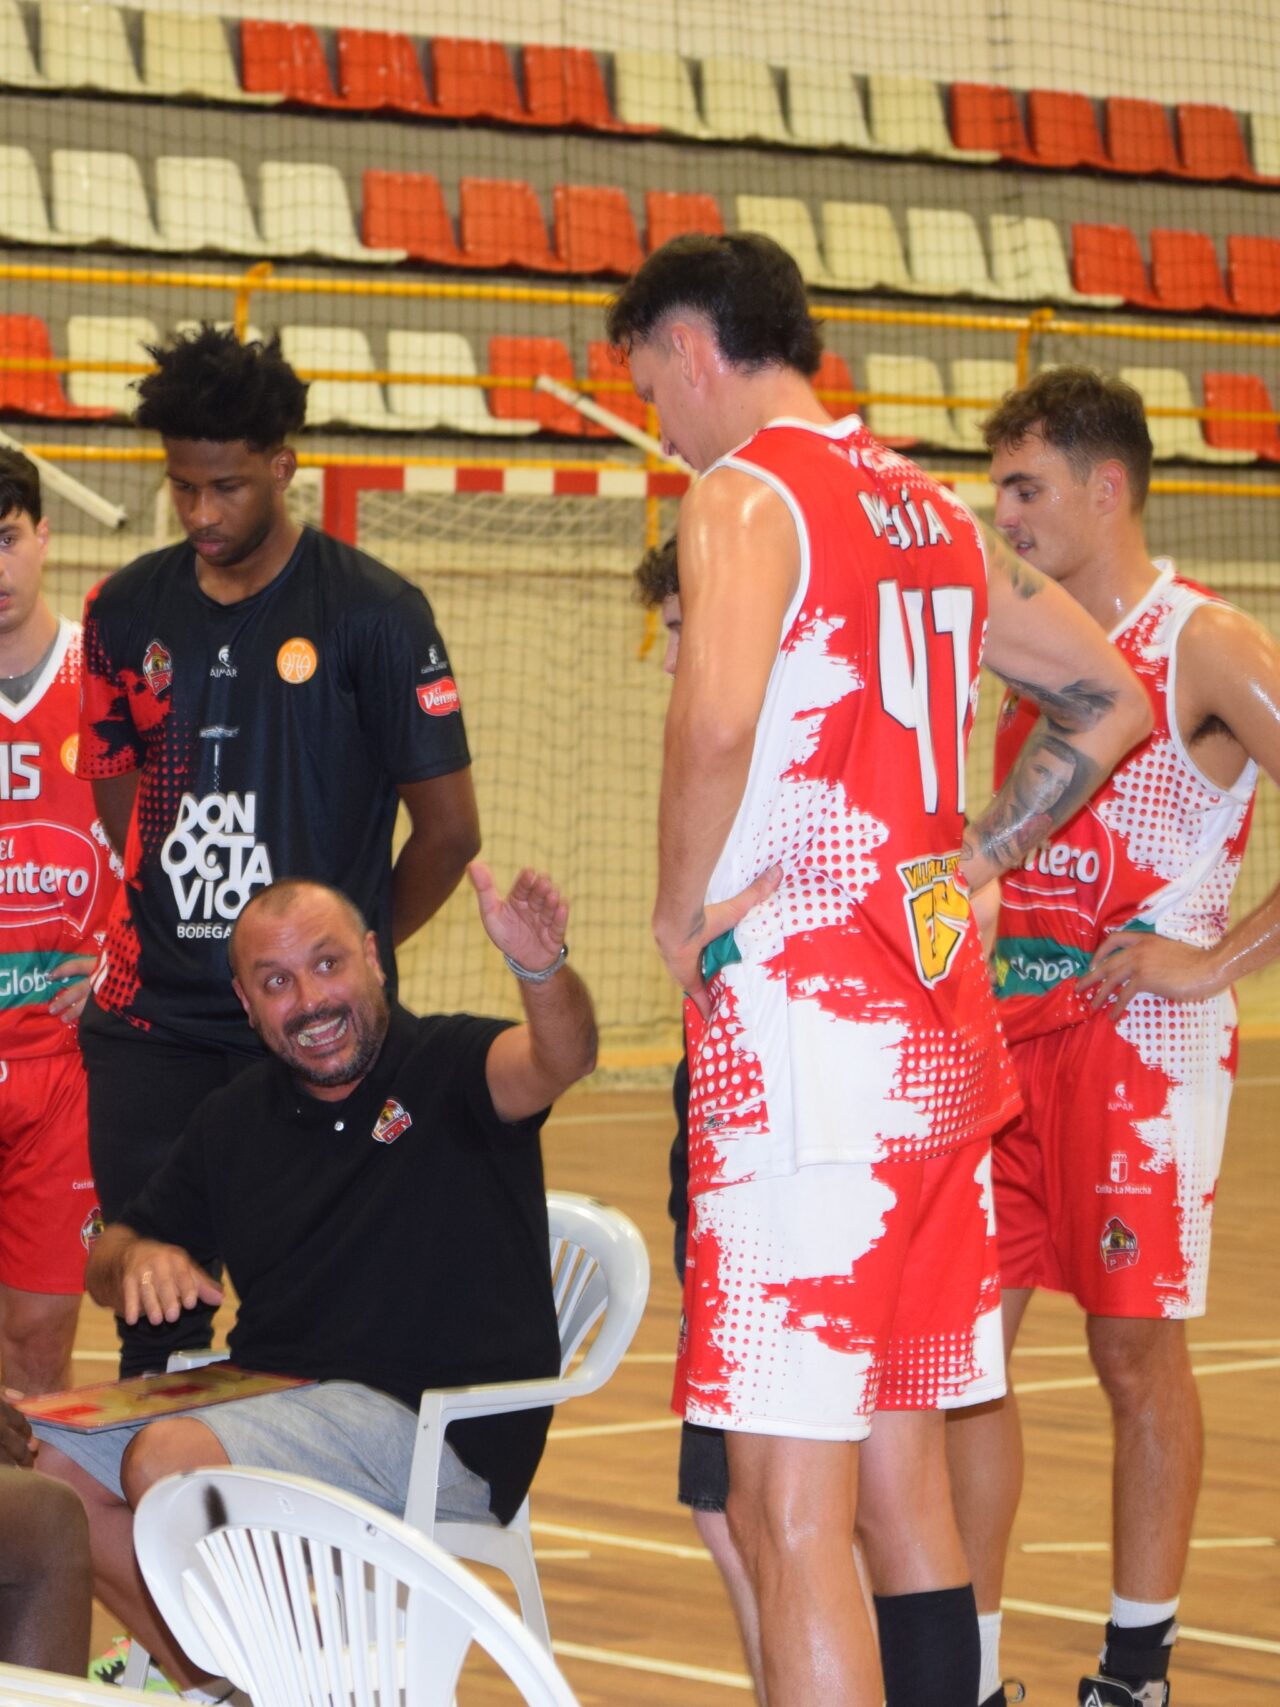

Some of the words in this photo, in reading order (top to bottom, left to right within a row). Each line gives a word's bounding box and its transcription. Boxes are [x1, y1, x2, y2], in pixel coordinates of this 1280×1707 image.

[210, 668, 238, 678] AIMAR
[175, 792, 256, 833] DON
[161, 831, 272, 886] OCTA
[1024, 843, 1100, 883] tero
[177, 923, 232, 939] BODEGA
[1124, 1185, 1152, 1195] Mancha
